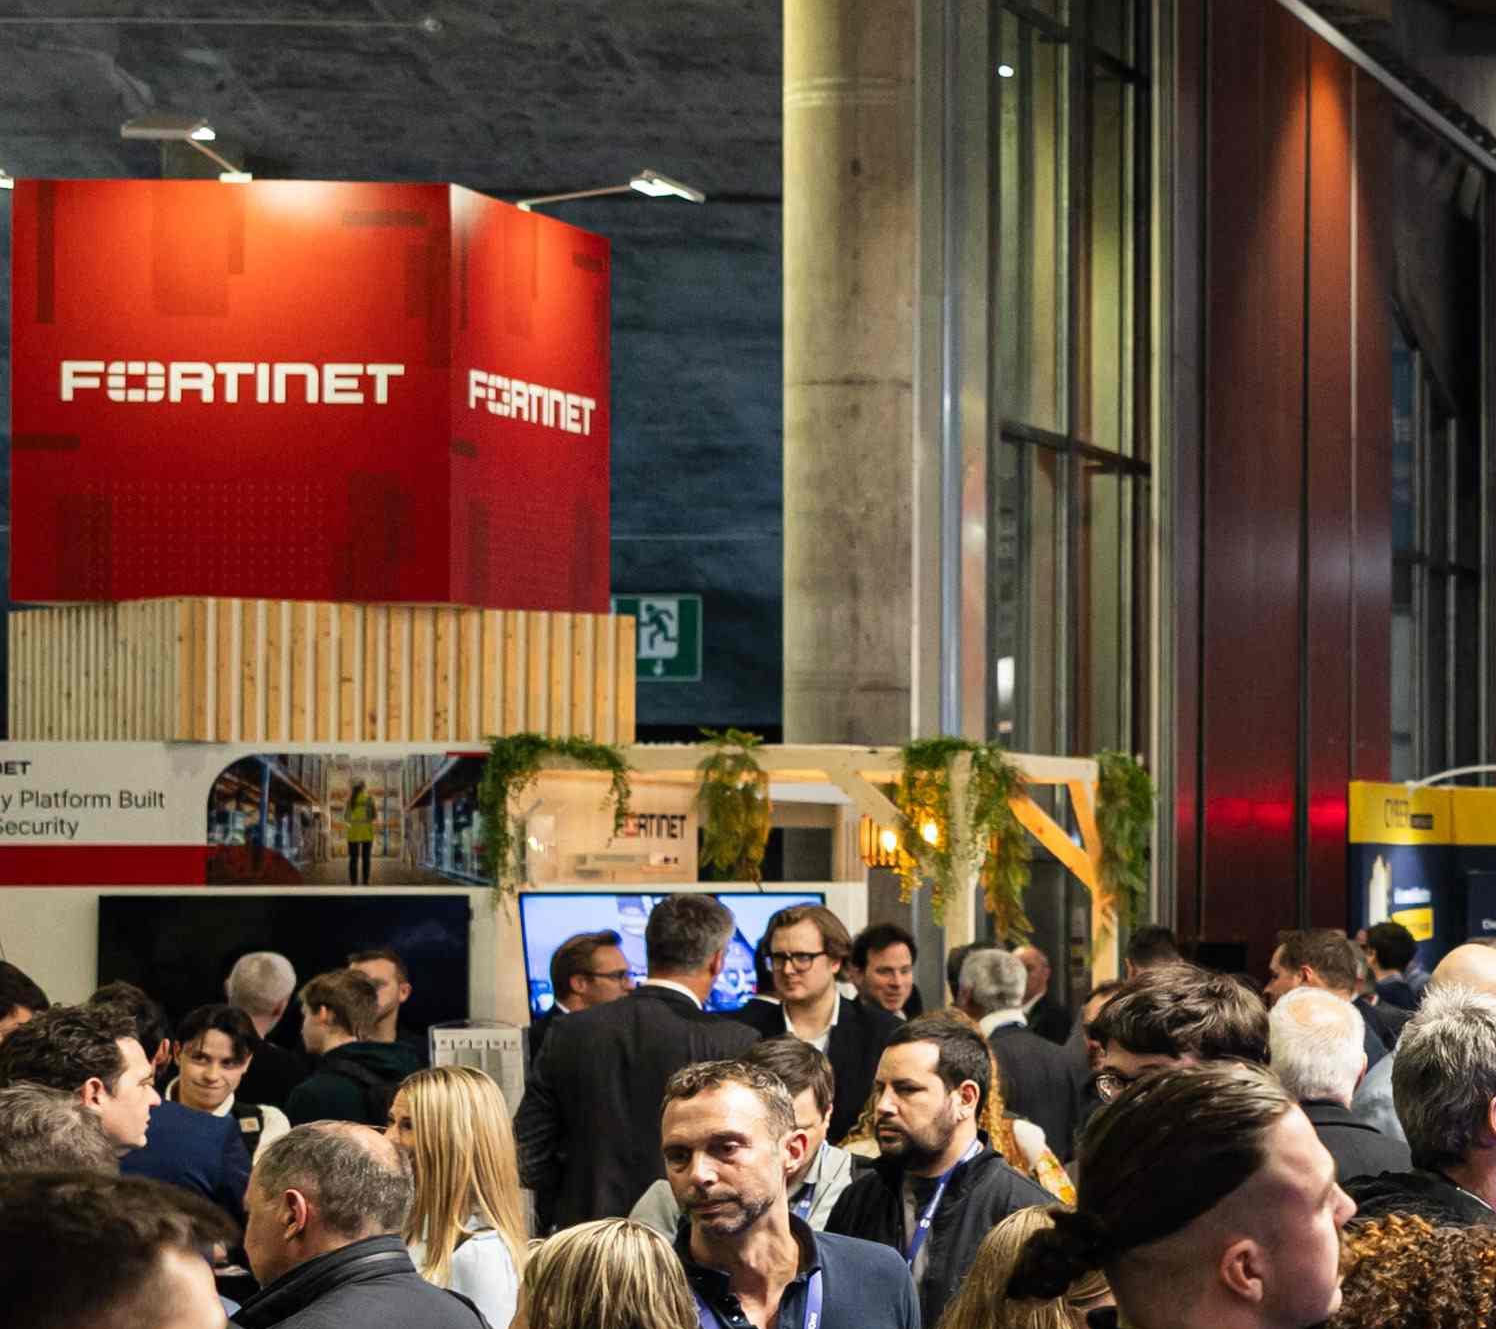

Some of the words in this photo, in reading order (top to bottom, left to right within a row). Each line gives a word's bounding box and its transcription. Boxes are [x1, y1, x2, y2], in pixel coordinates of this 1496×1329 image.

[61, 360, 405, 404] FORTINET
[469, 369, 596, 436] FORTINET
[20, 789, 112, 809] Platform
[119, 789, 165, 809] Built
[616, 812, 687, 839] ORTINET
